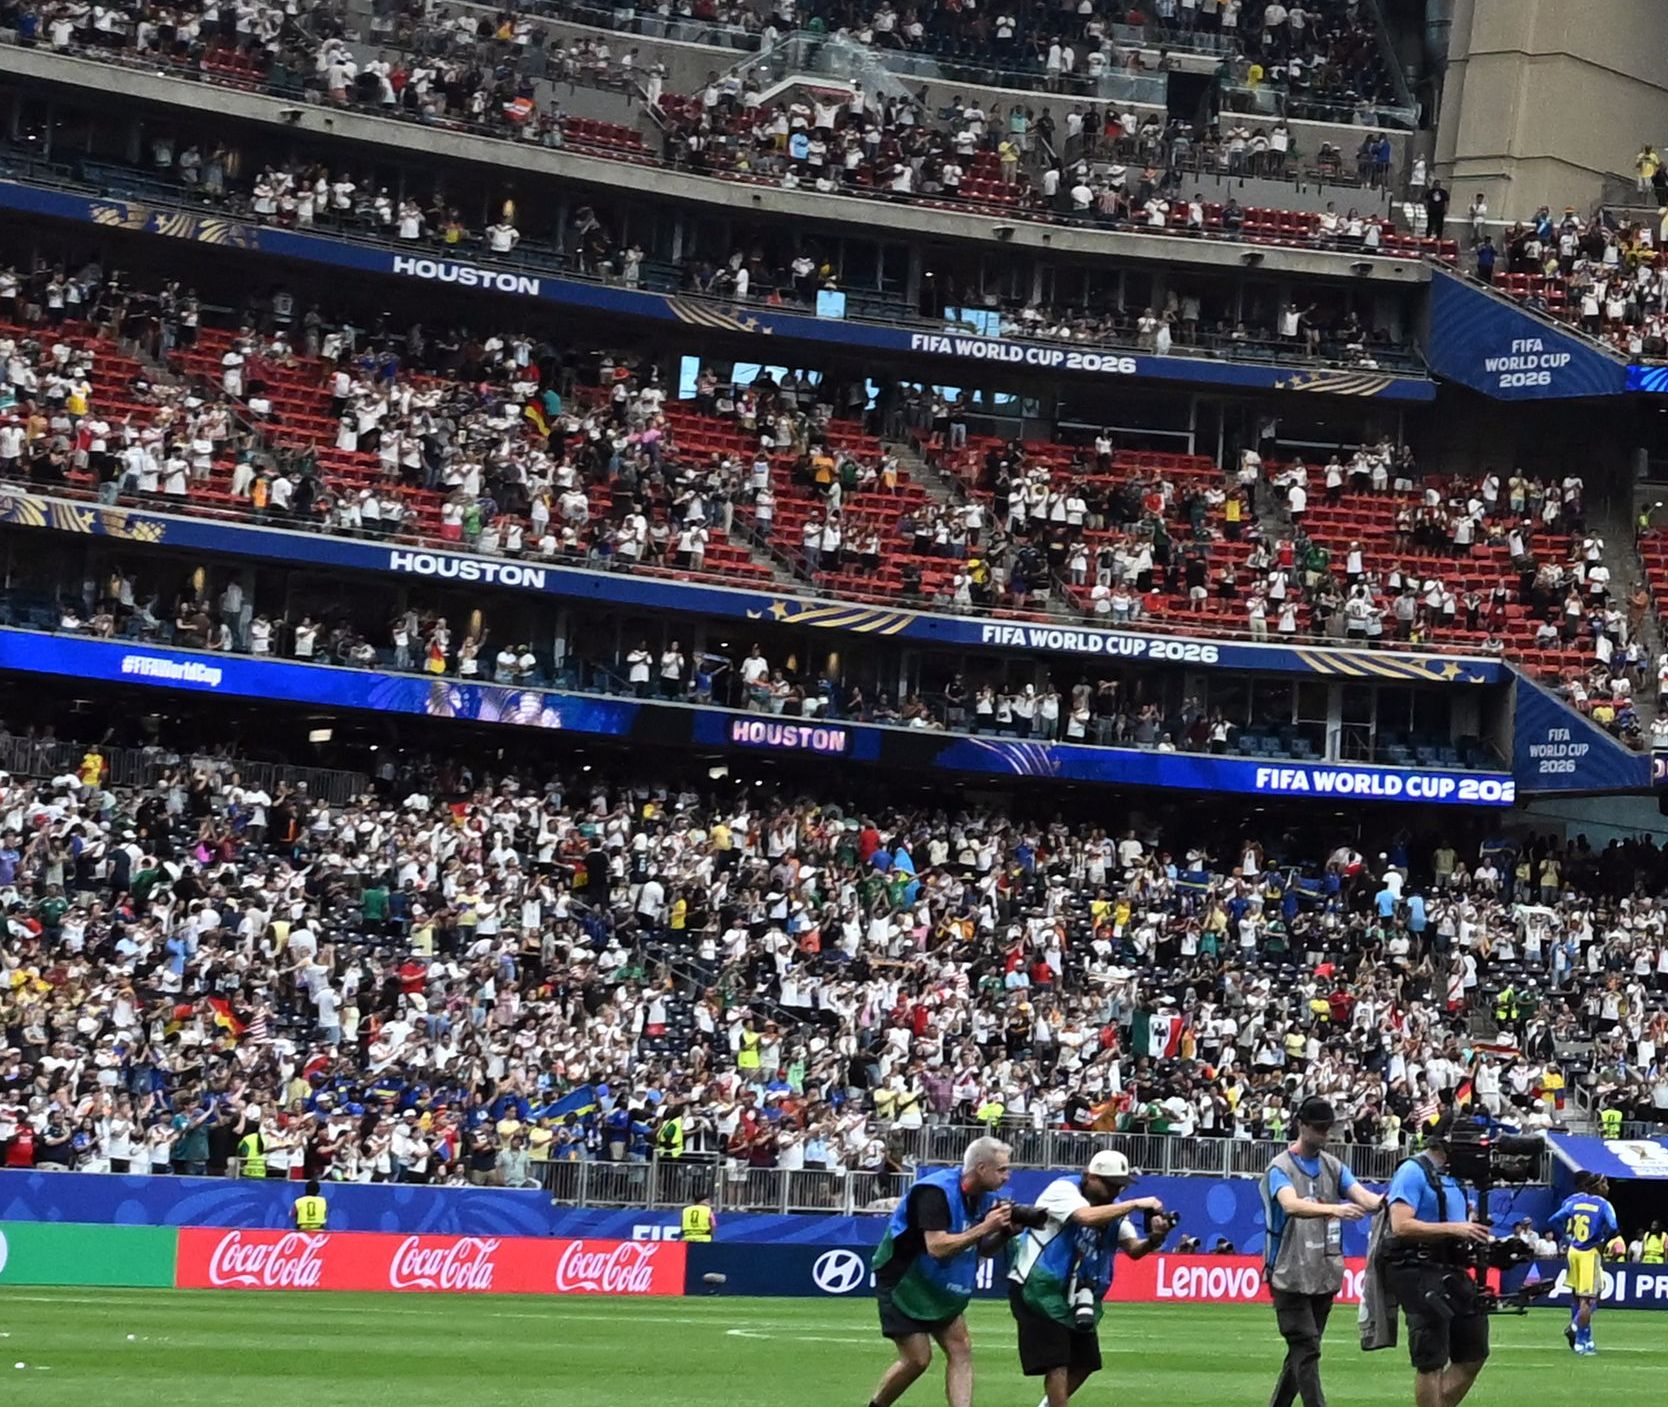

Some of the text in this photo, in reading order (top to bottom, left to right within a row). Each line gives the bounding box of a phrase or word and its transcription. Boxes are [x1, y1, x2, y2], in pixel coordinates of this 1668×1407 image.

[393, 256, 540, 296] HOUSTON
[911, 333, 1137, 375] FIFA WORLD CUP 2026
[1484, 353, 1571, 372] WORLD CUP
[1511, 339, 1543, 354] FIFA
[1499, 371, 1552, 388] 2026
[390, 550, 547, 590] HOUSTON
[982, 625, 1219, 664] FIFA WORLD CUP 2026
[121, 654, 222, 687] #FIFAWorldCup
[731, 720, 846, 752] HOUSTON
[1529, 741, 1589, 758] WORLD CUP
[1547, 728, 1570, 742] FIFA
[1256, 767, 1308, 791] FIFA
[1313, 771, 1403, 796] WORLD
[1406, 775, 1456, 799] CUP
[1539, 759, 1576, 774] 2026
[209, 1229, 330, 1288] Coca-Cola
[389, 1235, 501, 1290] Coca-Cola
[556, 1238, 659, 1292] Coca-Cola
[1156, 1256, 1261, 1300] Lenovo
